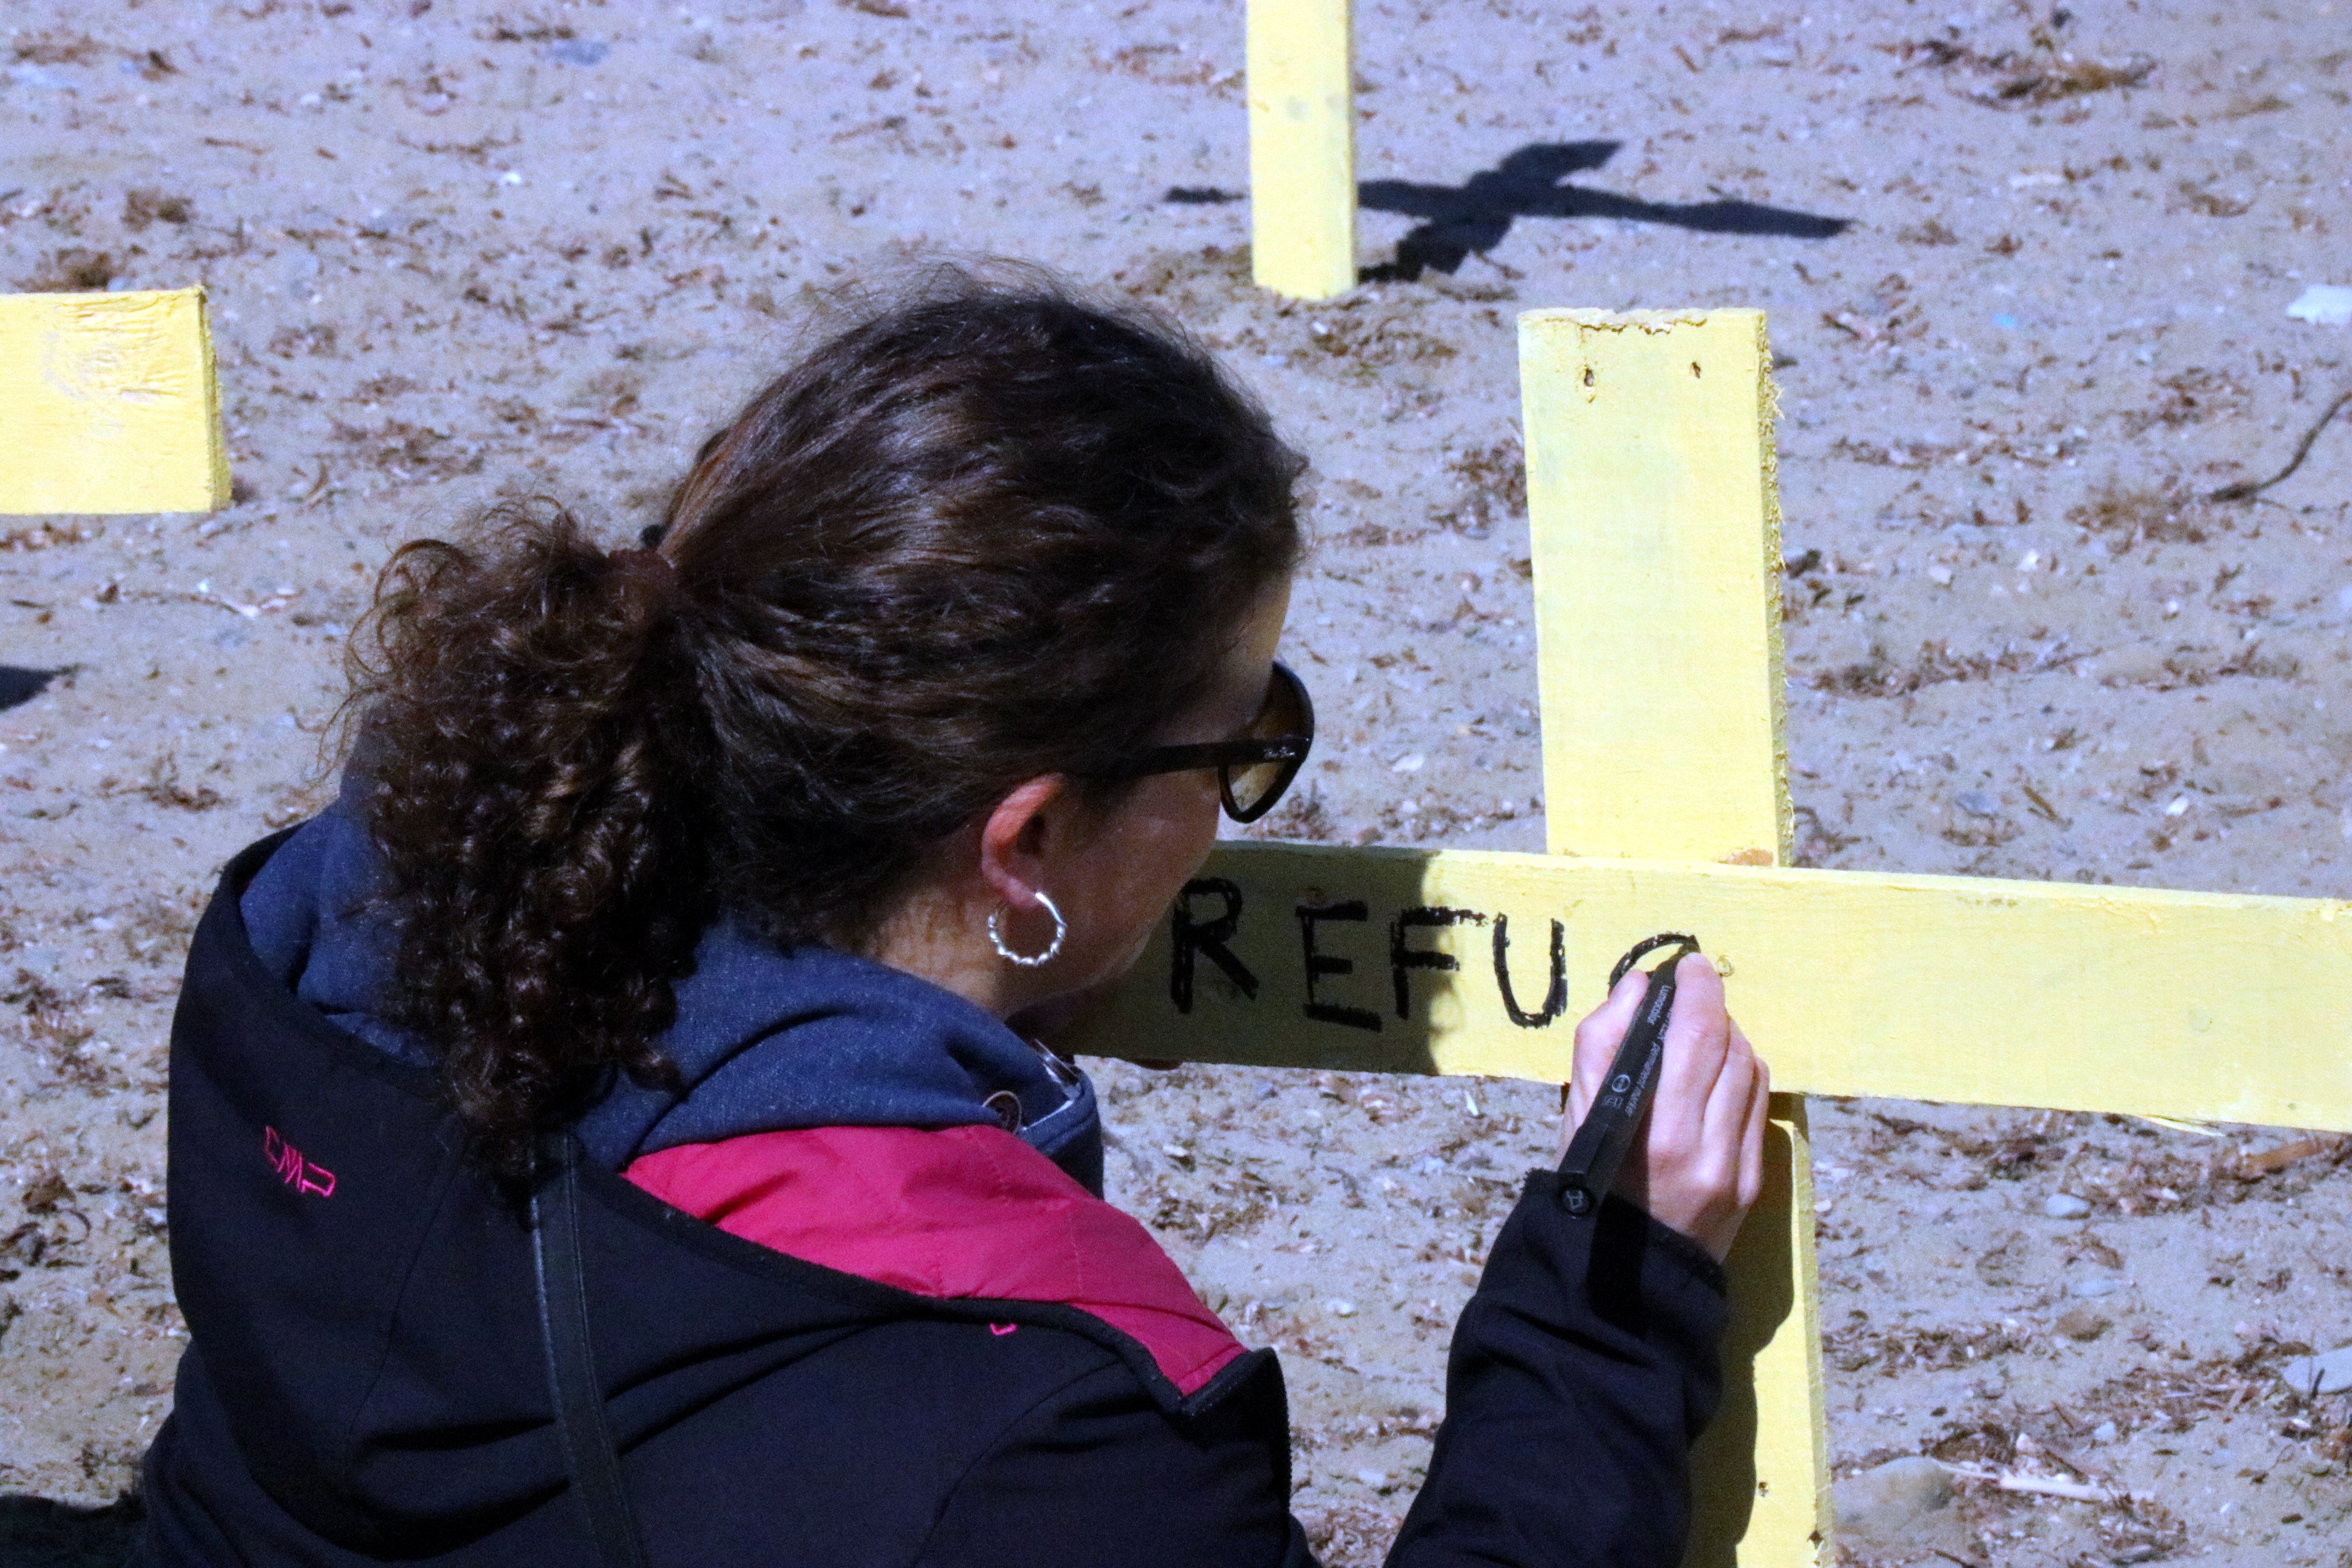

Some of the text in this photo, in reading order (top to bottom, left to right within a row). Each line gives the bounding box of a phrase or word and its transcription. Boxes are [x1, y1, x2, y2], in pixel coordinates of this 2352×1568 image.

[1647, 984, 1673, 1025] Lumocolor
[1624, 1041, 1660, 1117] permanent marker
